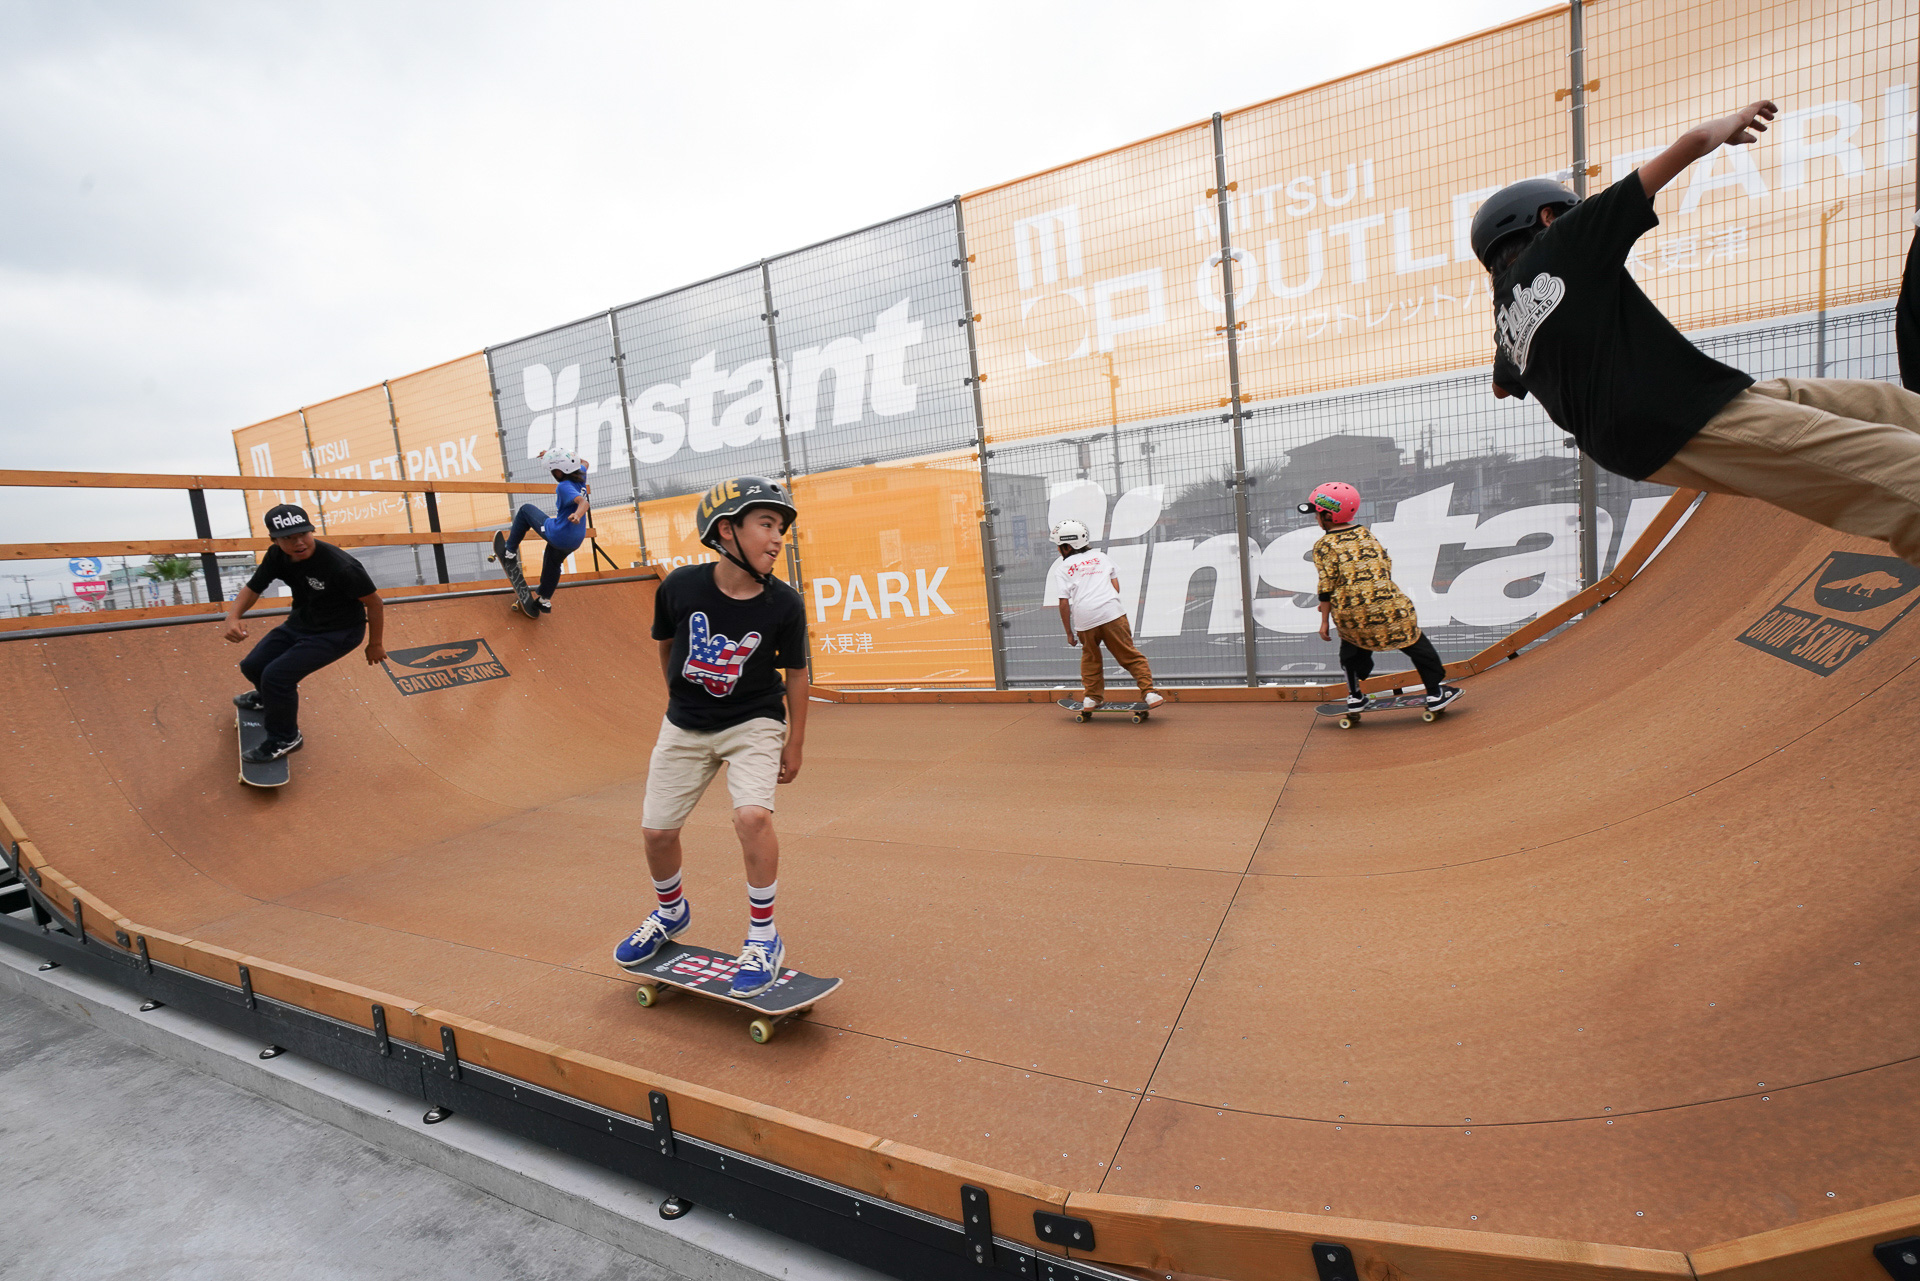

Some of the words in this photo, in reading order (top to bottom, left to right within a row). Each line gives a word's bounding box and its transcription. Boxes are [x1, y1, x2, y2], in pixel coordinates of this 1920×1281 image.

[1193, 158, 1375, 241] MITSUI
[1534, 300, 1553, 317] MAD
[523, 297, 924, 475] instant
[302, 438, 350, 469] MITSUI
[406, 434, 482, 481] PARK
[812, 566, 955, 623] PARK
[819, 631, 874, 654] 木更津
[1746, 610, 1811, 648] GATOR
[1791, 624, 1870, 668] SKINS
[399, 672, 451, 693] GATOR
[457, 664, 504, 682] SKINS
